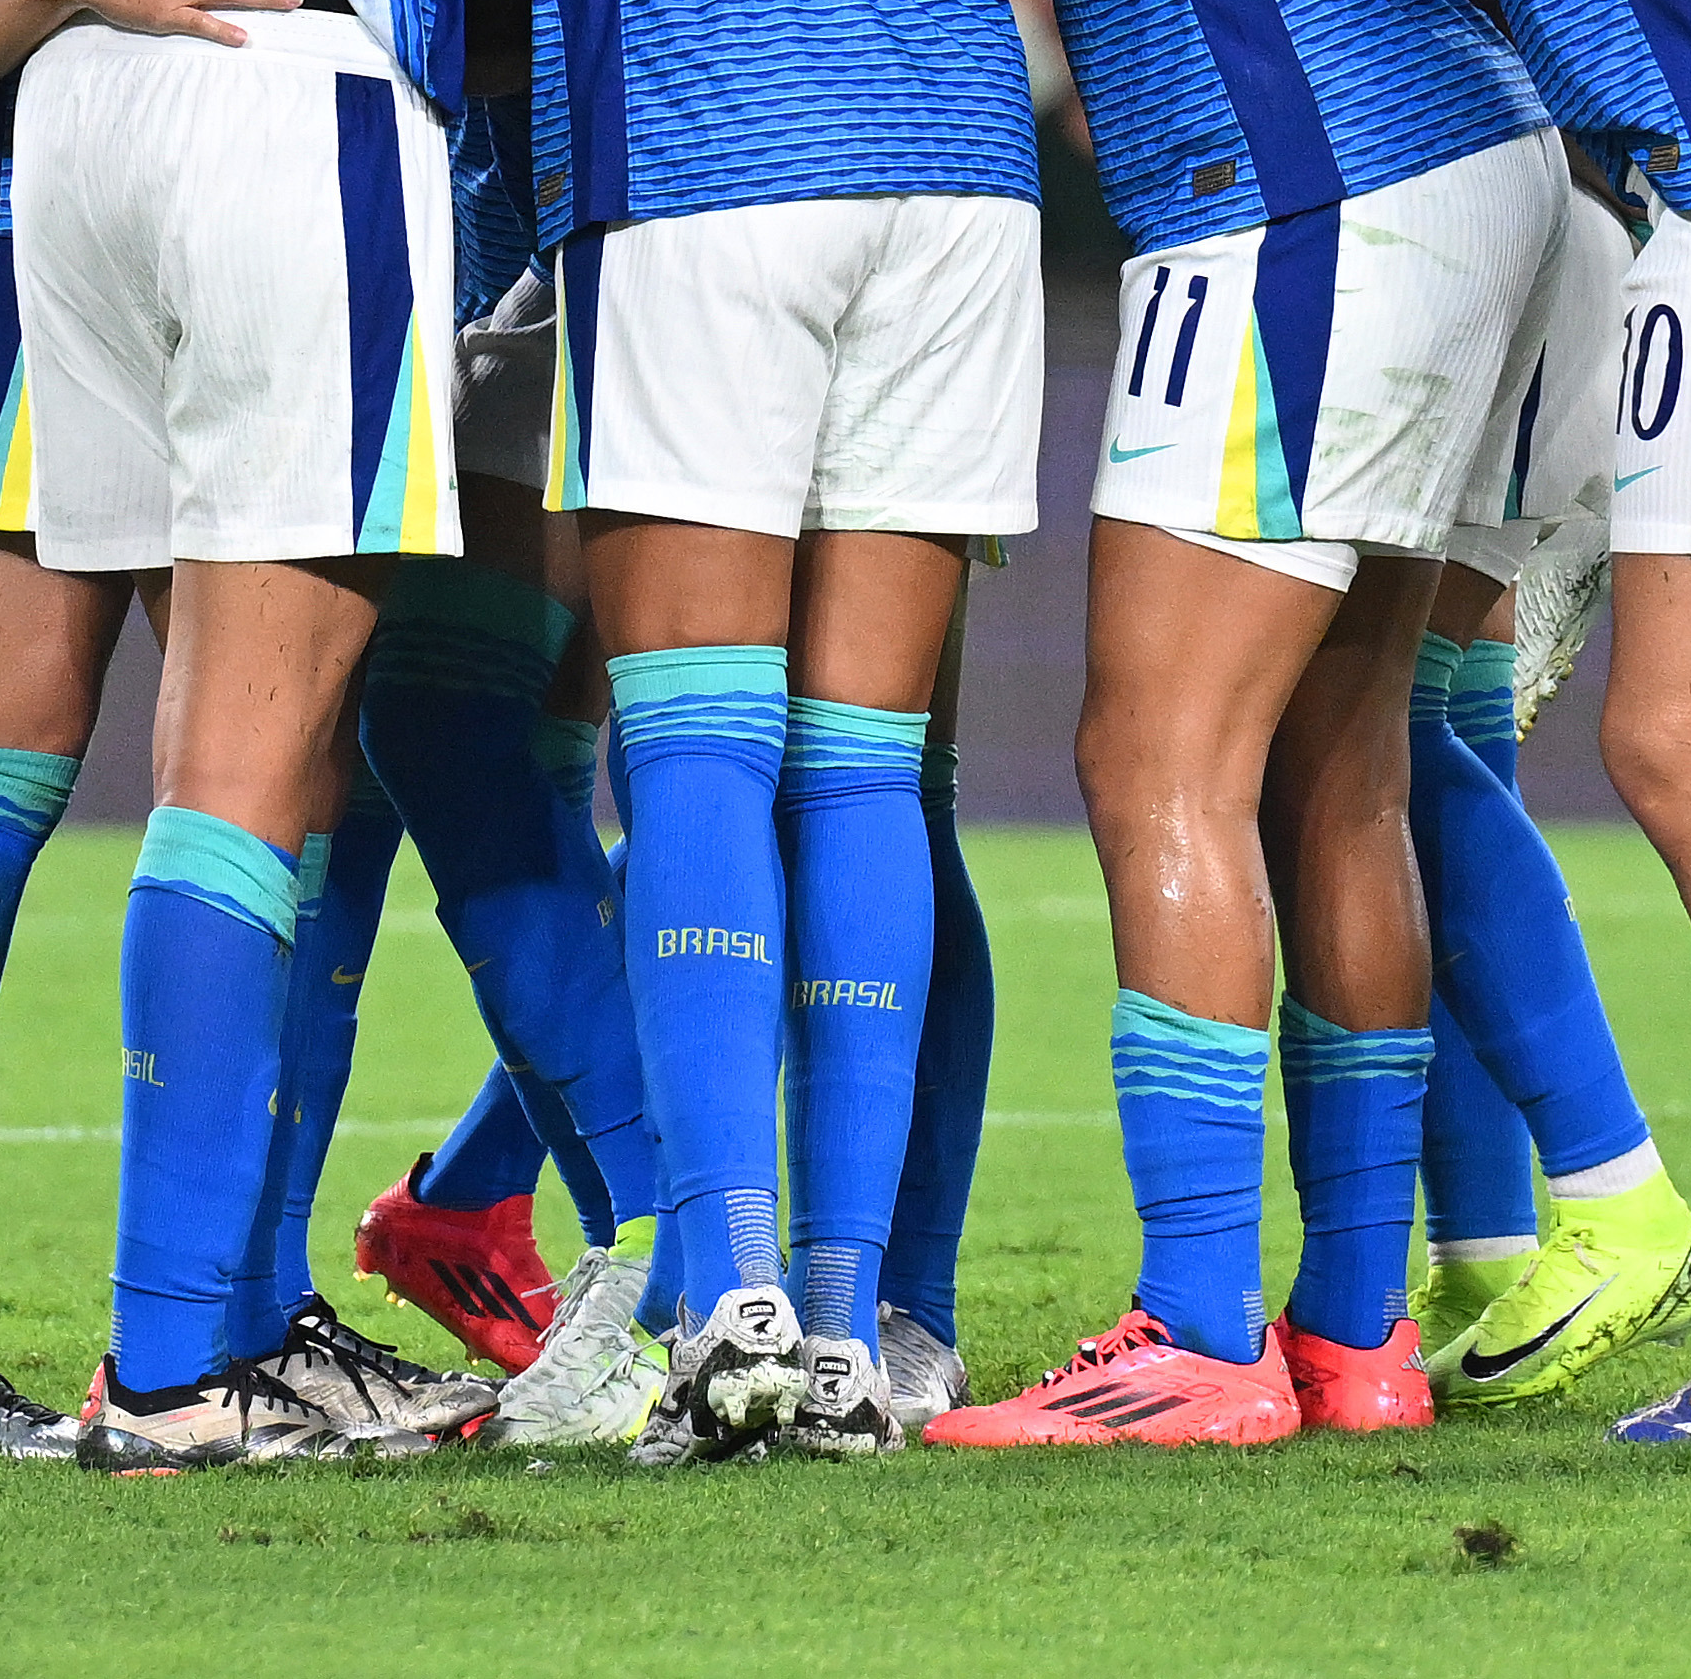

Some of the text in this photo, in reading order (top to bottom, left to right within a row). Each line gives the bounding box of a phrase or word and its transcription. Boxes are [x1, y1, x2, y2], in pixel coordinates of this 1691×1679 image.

[1127, 265, 1209, 408] 11
[657, 927, 773, 965] BRASIL
[792, 979, 902, 1011] BRASIL
[121, 1046, 165, 1087] ASIL
